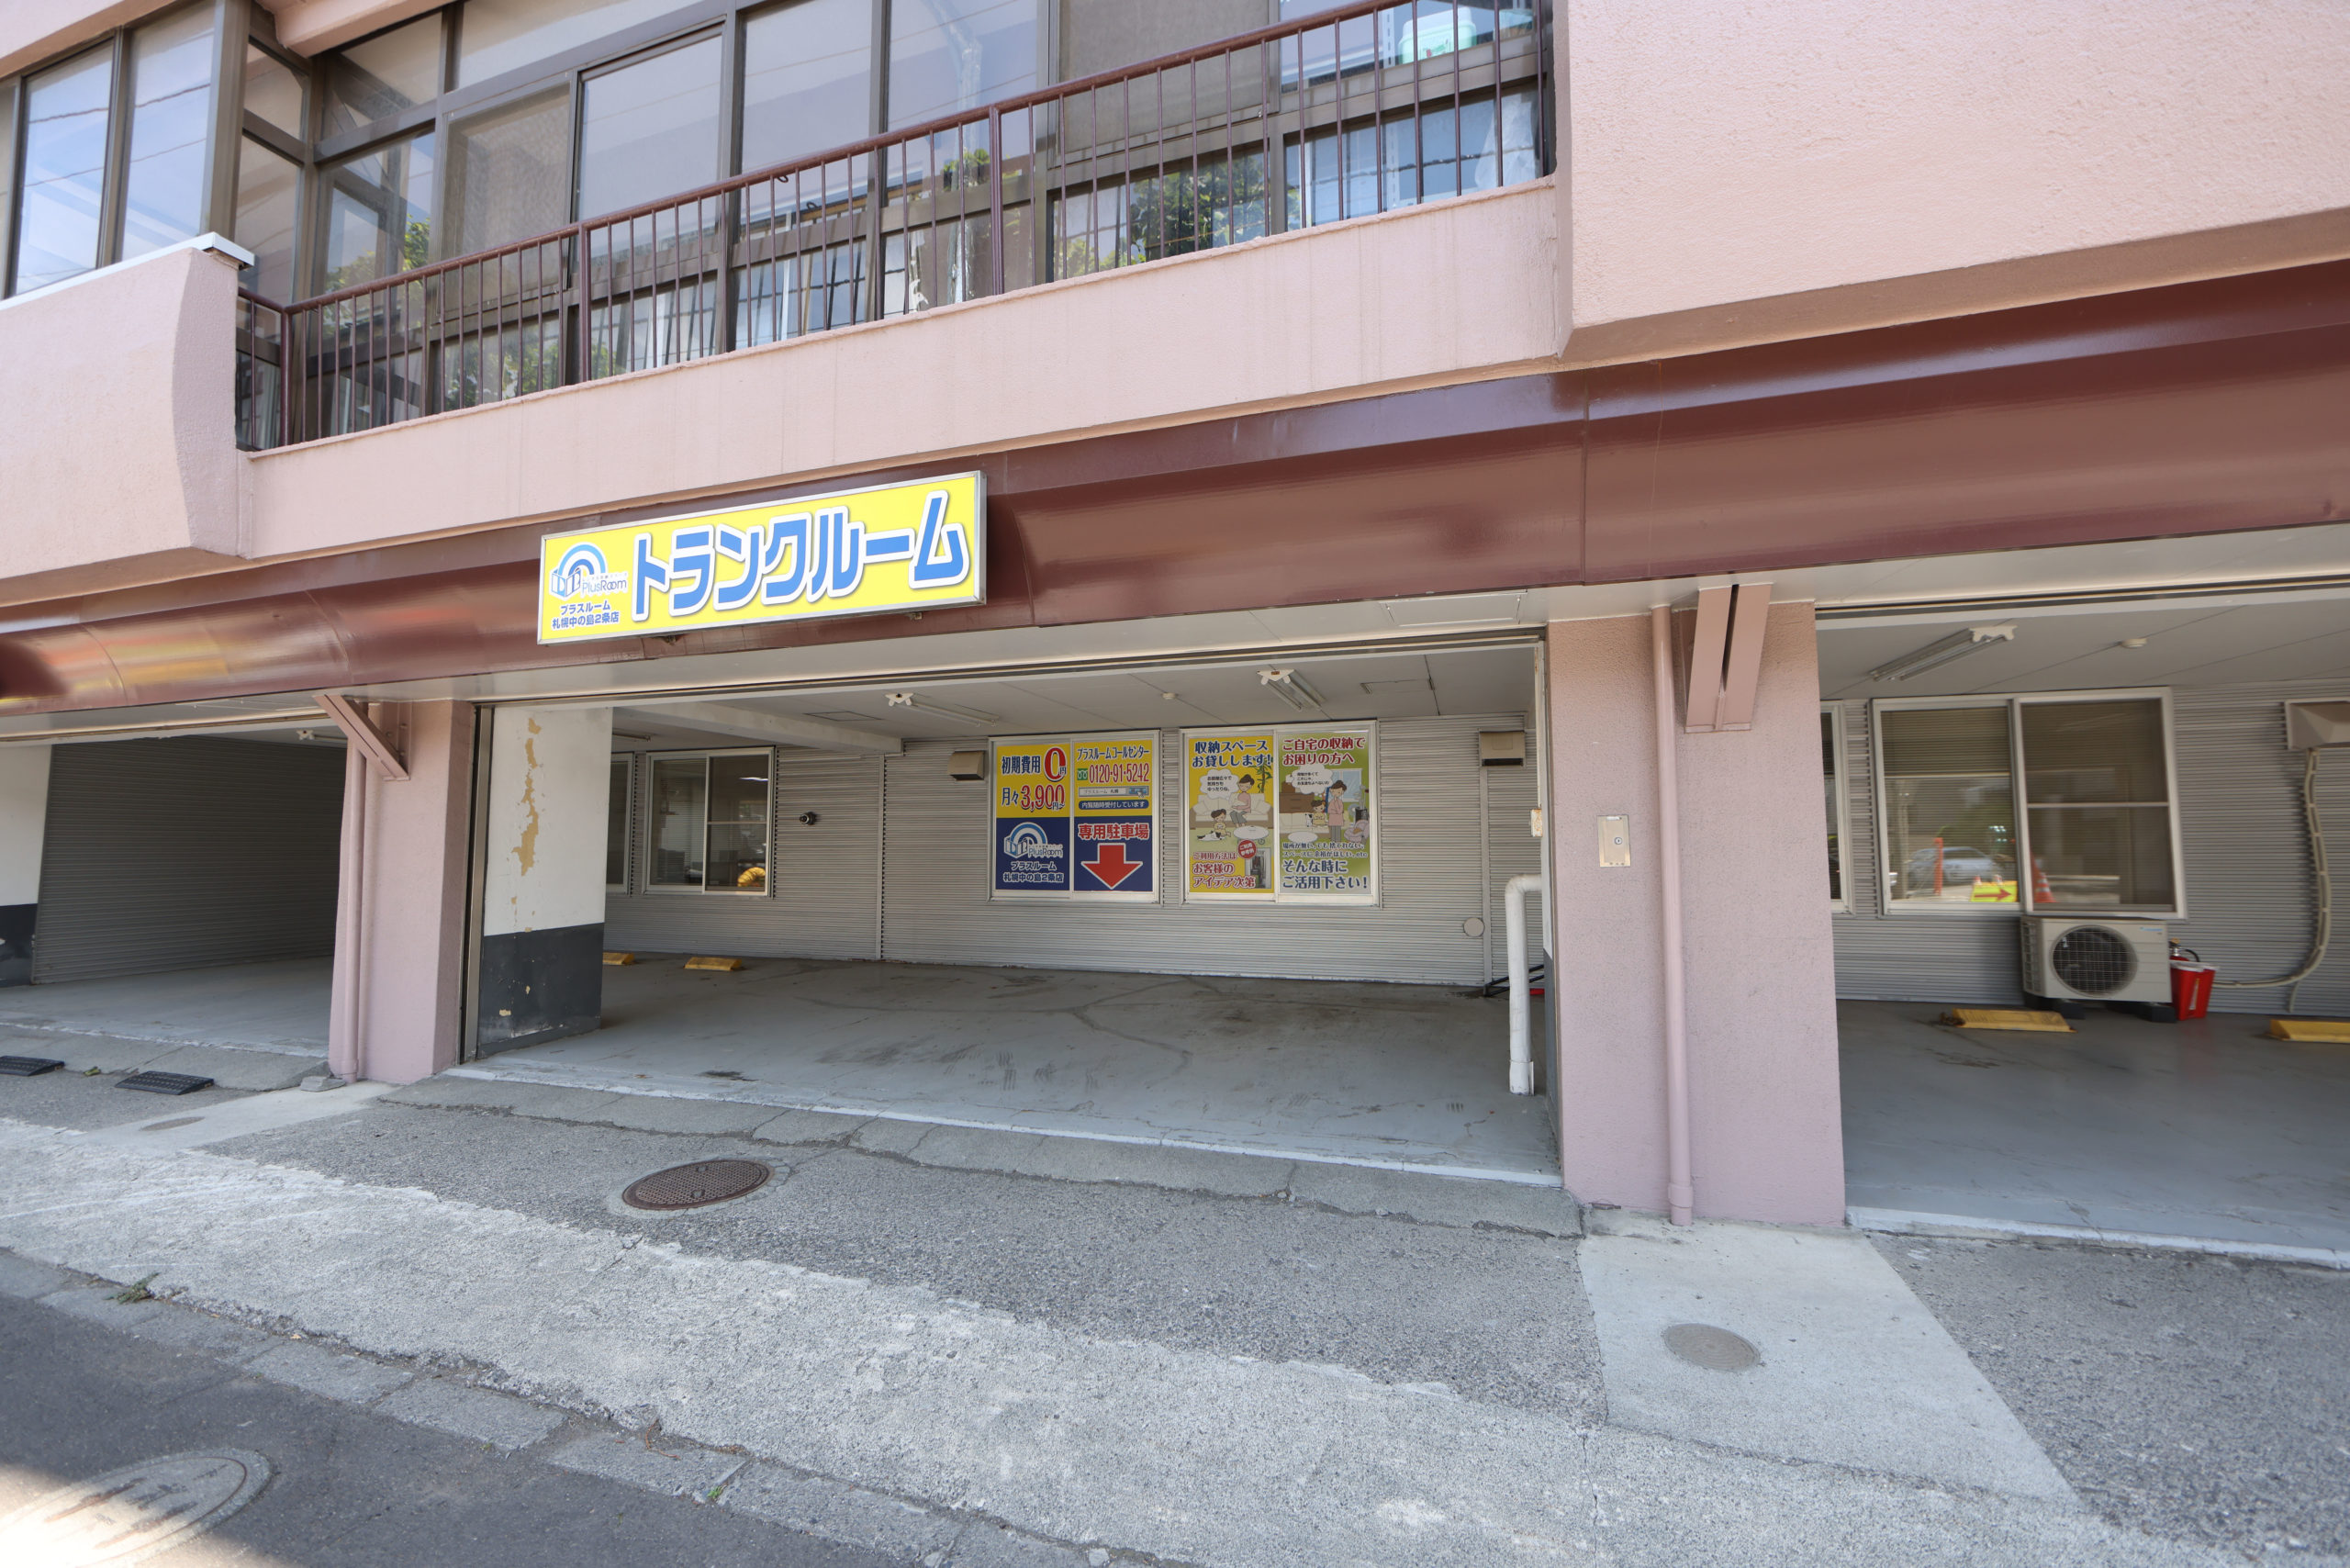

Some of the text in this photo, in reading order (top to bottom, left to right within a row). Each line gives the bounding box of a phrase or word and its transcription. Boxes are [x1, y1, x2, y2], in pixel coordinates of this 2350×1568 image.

[634, 493, 968, 618] トランクルーム
[582, 579, 627, 595] PlusRoom
[560, 600, 611, 615] プラスルーム
[552, 611, 620, 629] 札幌中の島2条店
[1194, 740, 1269, 754] 収納スペース
[1282, 736, 1366, 751] ご自宅の収納で
[1077, 745, 1150, 760] プラスルームコールセンター
[1282, 752, 1355, 766] お困りの方へ
[1078, 823, 1150, 840] 専用駐車場
[1011, 861, 1057, 870] プラスルーム
[1193, 863, 1235, 874] お客様の
[1282, 859, 1348, 873] そんな時に
[1003, 873, 1064, 882] 札幌中の島2条店
[1193, 876, 1256, 888] アイデア次第
